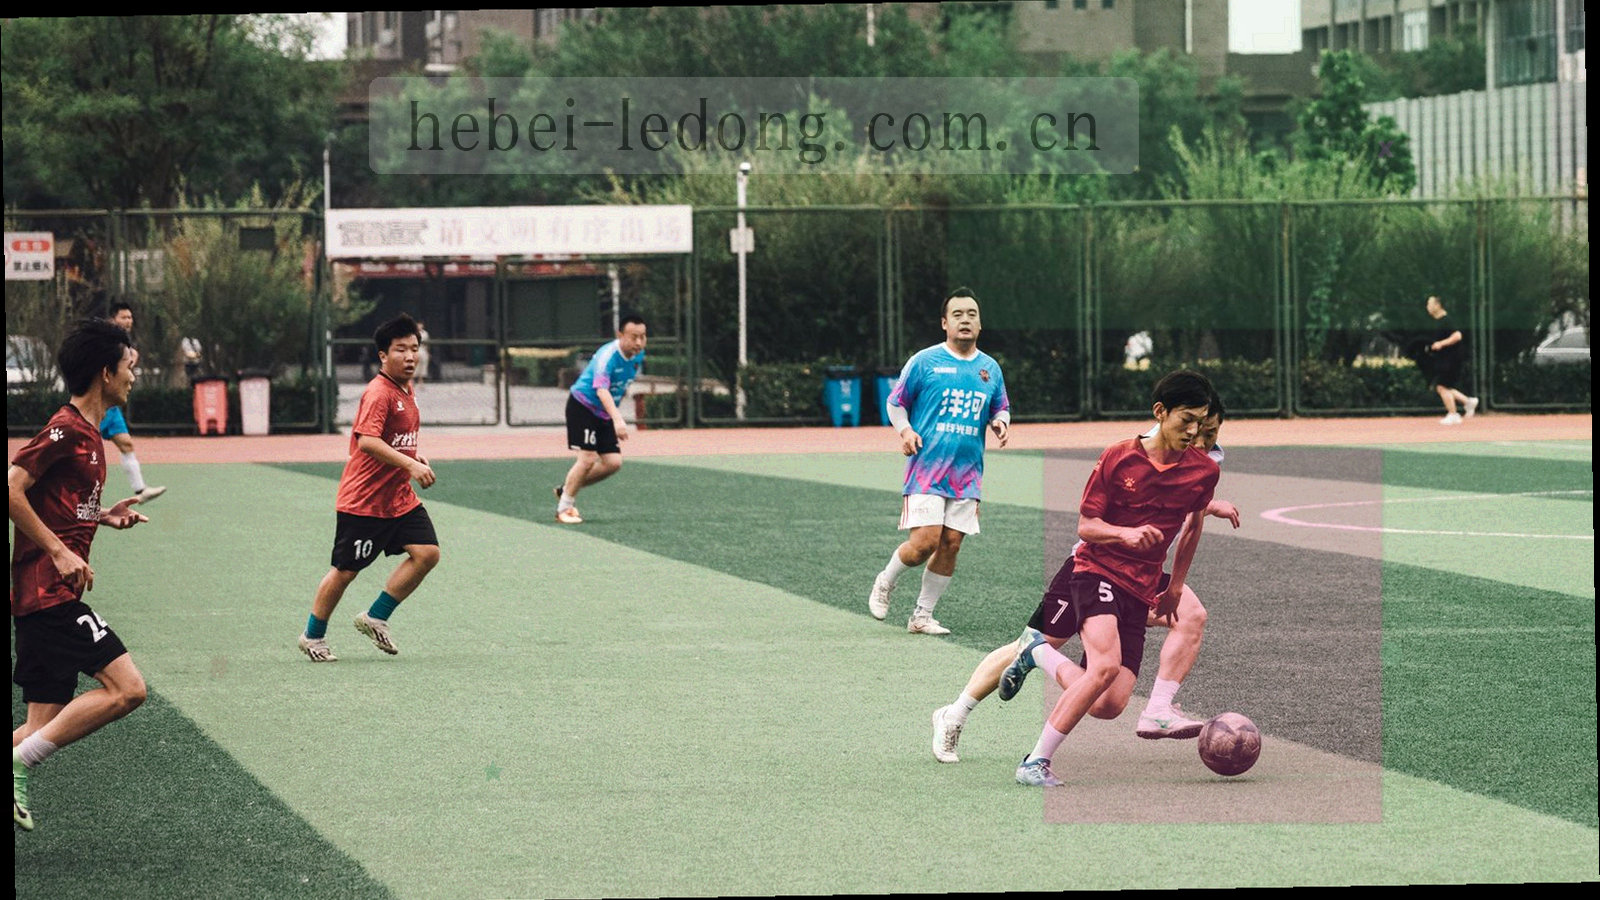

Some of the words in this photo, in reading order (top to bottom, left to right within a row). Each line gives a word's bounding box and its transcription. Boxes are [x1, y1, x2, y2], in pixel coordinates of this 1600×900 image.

[440, 215, 682, 246] 请文明有序出场
[939, 388, 988, 421] 洋河
[584, 428, 597, 445] 16
[353, 539, 373, 560] 10
[1098, 581, 1114, 602] 5
[1050, 599, 1069, 625] 7
